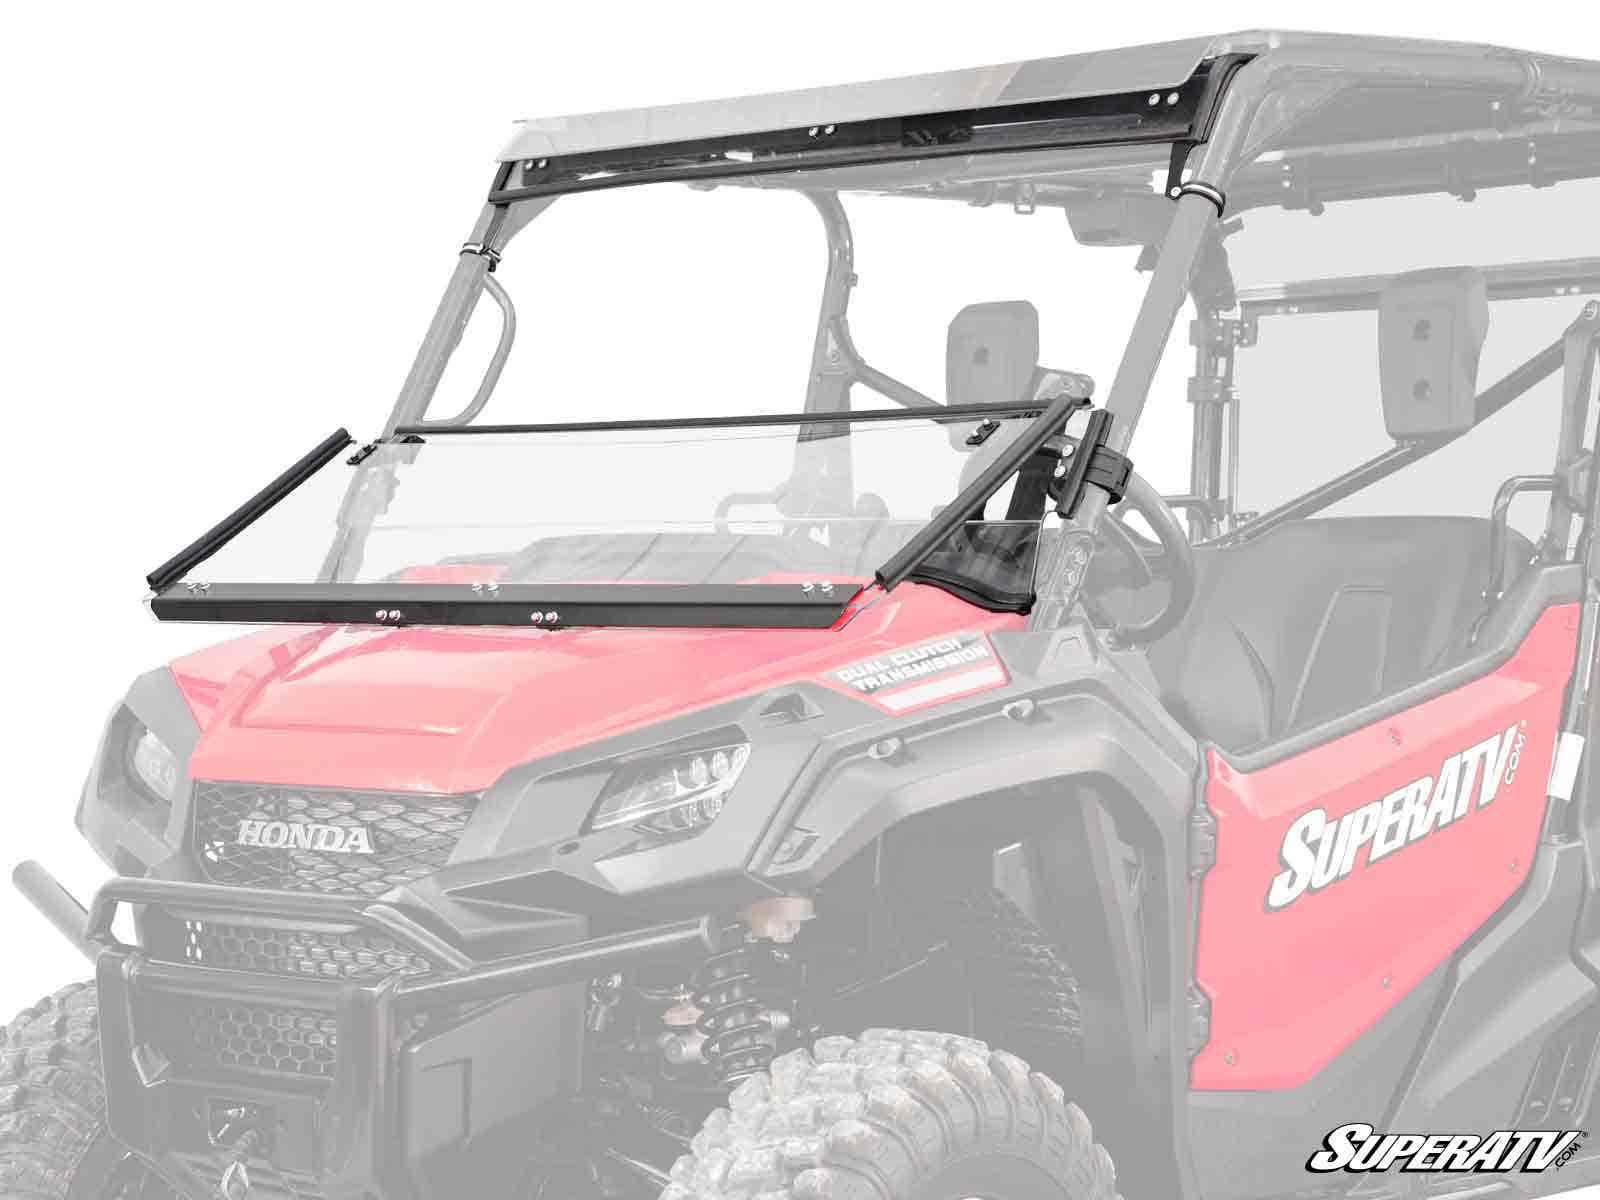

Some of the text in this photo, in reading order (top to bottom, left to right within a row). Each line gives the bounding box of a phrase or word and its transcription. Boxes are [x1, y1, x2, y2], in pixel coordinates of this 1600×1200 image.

[837, 639, 962, 682] DUAL CLUTCH
[852, 644, 989, 691] TRANSMISSION
[237, 819, 374, 854] HONDA
[1266, 722, 1519, 909] SUPERATV
